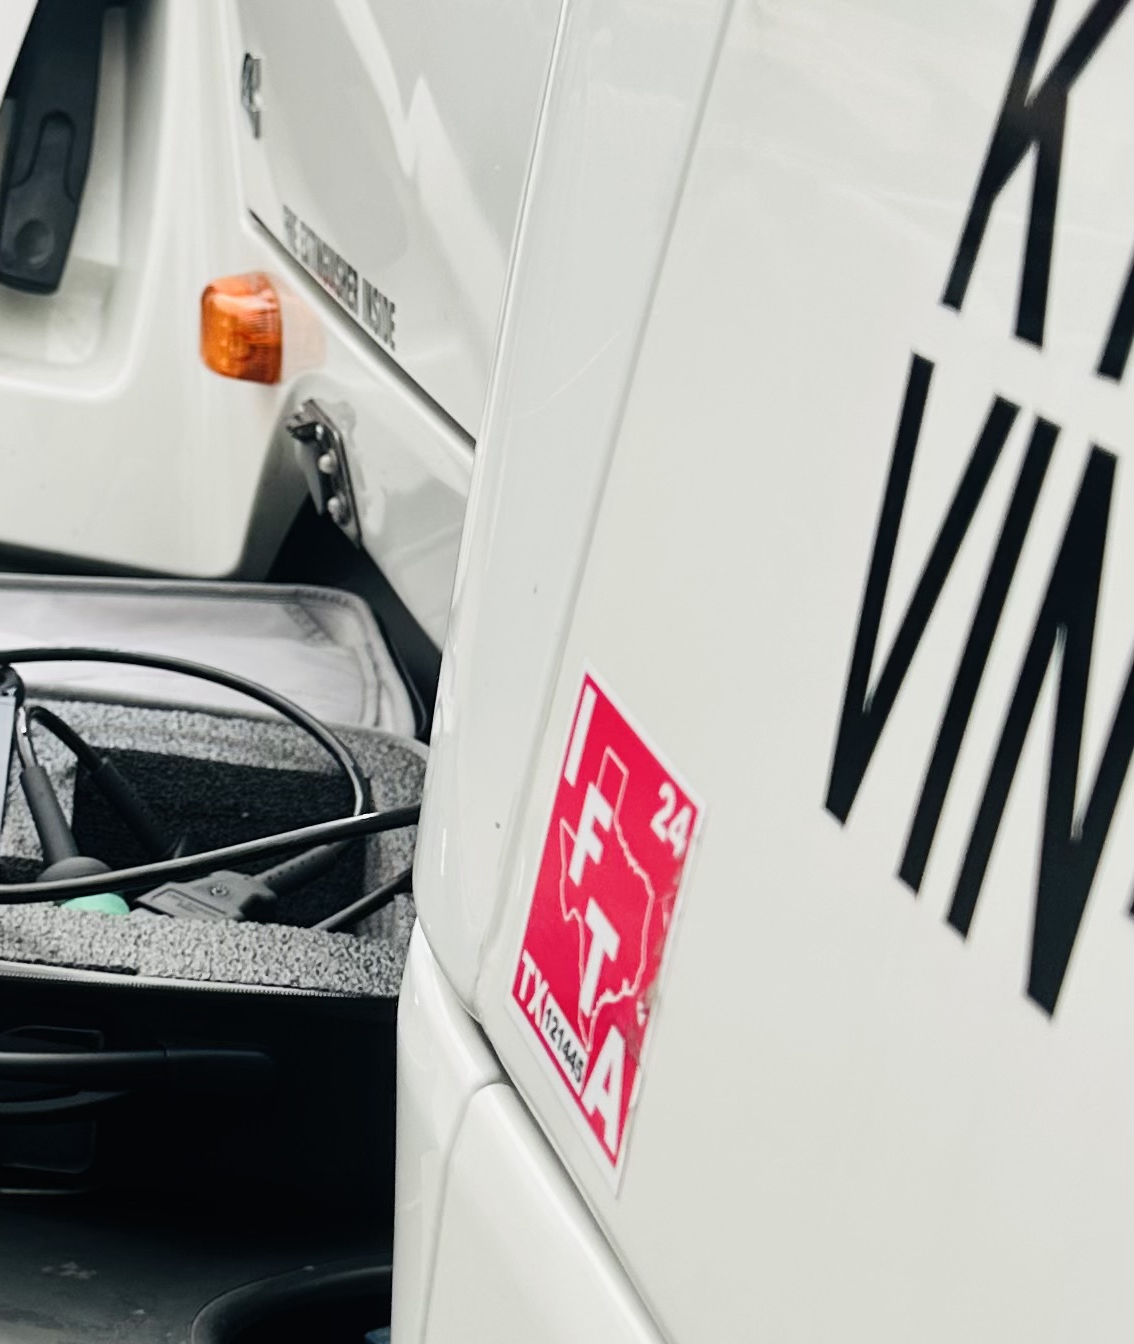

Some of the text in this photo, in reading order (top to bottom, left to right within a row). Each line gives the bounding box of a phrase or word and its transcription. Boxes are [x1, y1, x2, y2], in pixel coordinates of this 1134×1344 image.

[824, 351, 1134, 1019] VIN
[651, 782, 693, 858] 24
[521, 949, 549, 1031] TX
